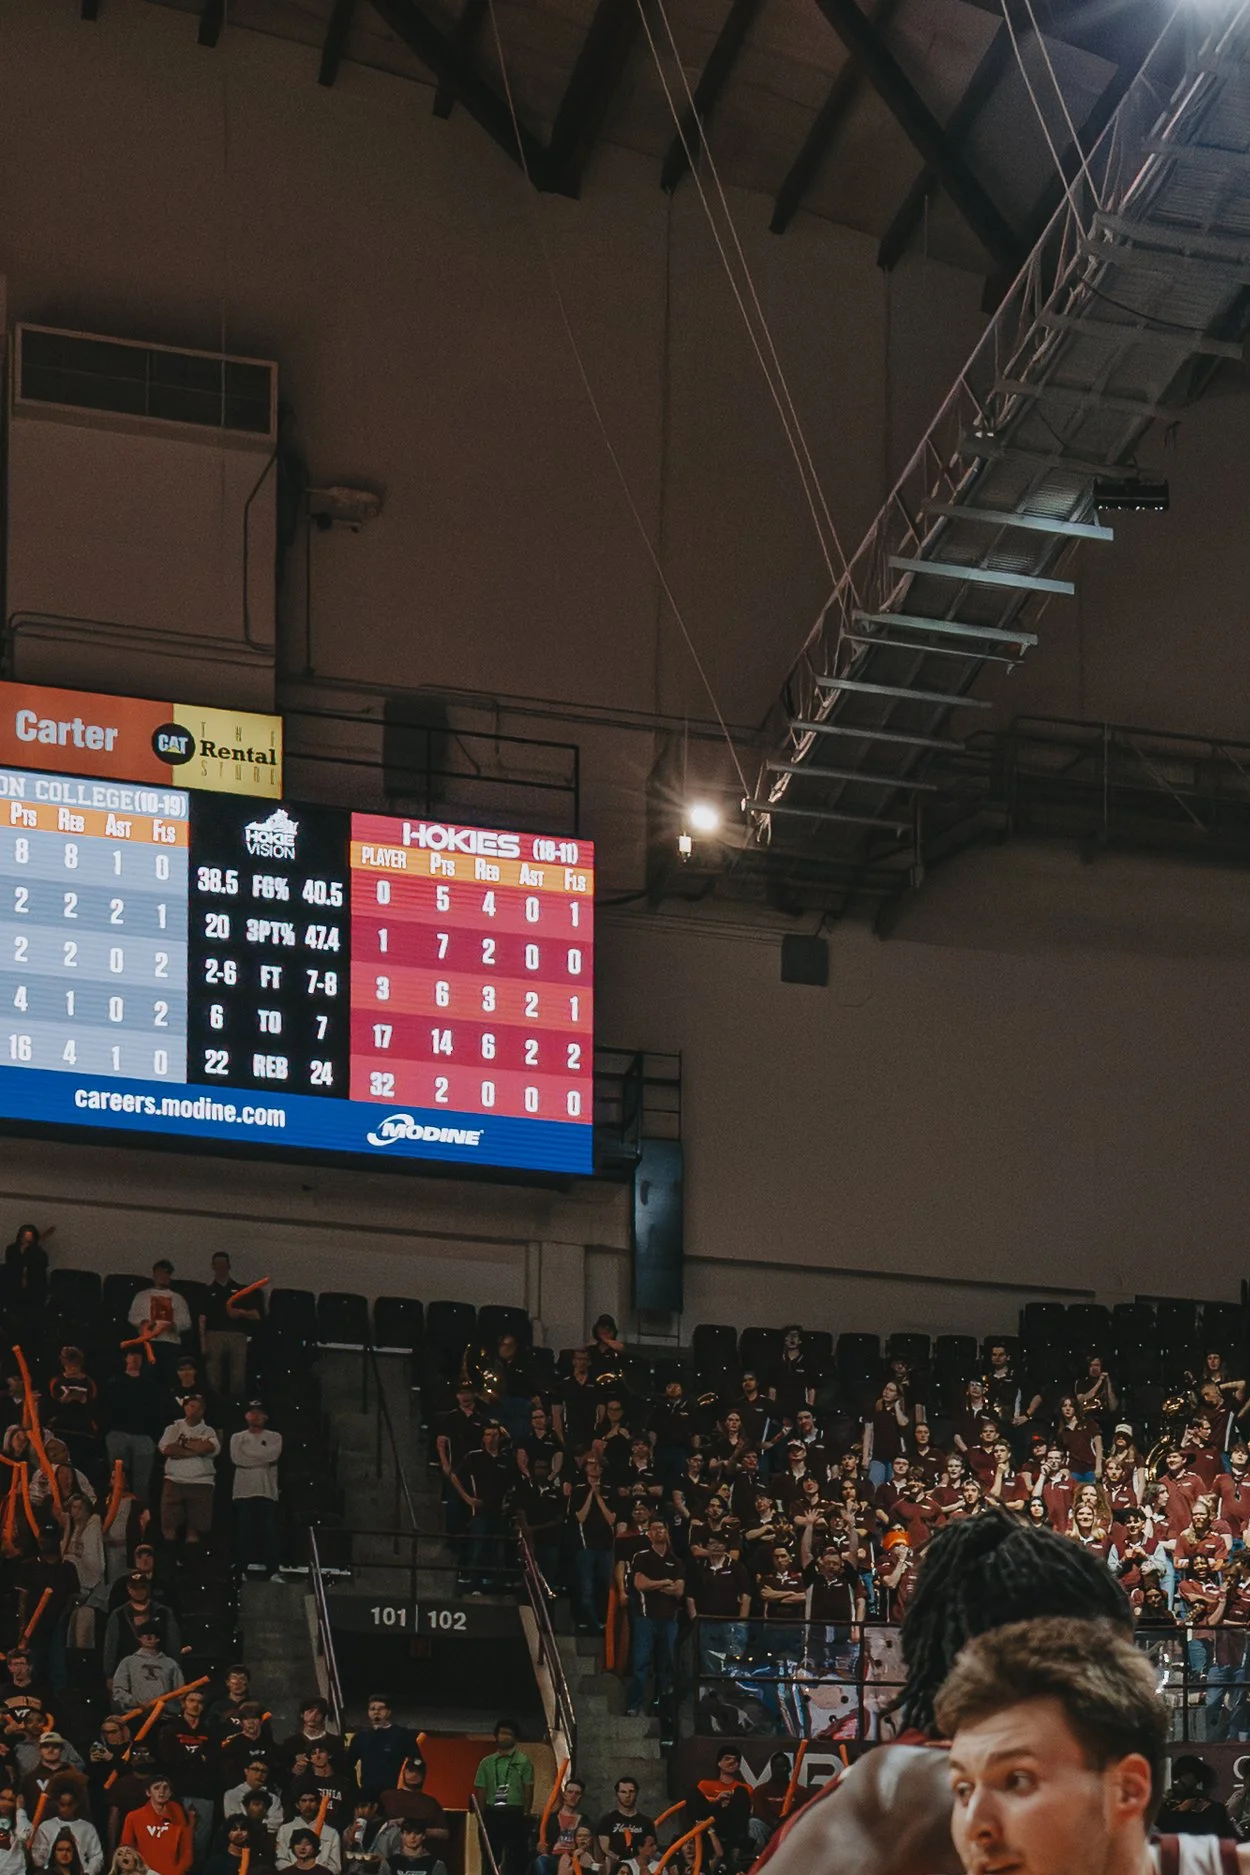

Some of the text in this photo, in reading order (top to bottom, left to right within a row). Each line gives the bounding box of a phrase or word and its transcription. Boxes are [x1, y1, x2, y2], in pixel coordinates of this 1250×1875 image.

[15, 708, 118, 752] Carter
[158, 733, 188, 755] CAT
[199, 739, 278, 766] Rental
[15, 837, 169, 881] 8 8 1 0
[246, 830, 295, 848] HOKIE
[246, 843, 296, 861] VISION
[362, 845, 407, 870] PLAYER
[402, 822, 521, 858] HOKIES
[197, 866, 343, 908] 38.5 FG% 40.5
[377, 879, 580, 928] 0 5 4 0 1
[14, 886, 167, 930] 2 2 2 1
[204, 912, 341, 952] 20 3PT% 47.4
[378, 927, 582, 976] 1 7 2 0 0
[14, 936, 169, 978] 2 2 0 2
[204, 958, 338, 997] 2-6 FT 7-8
[13, 985, 169, 1027] 4 1 0 2
[375, 975, 580, 1023] 3 6 3 2 1
[209, 1003, 329, 1041] 6 TO 7
[8, 1033, 168, 1076] 16 4 1 0
[372, 1023, 581, 1070] 17 14 6 2 2
[204, 1049, 335, 1087] 22 REB 24
[74, 1088, 286, 1129] careers.modine.com
[369, 1071, 581, 1117] 32 2 0 0 0
[380, 1121, 483, 1147] MODINE
[371, 1606, 467, 1631] 101 102
